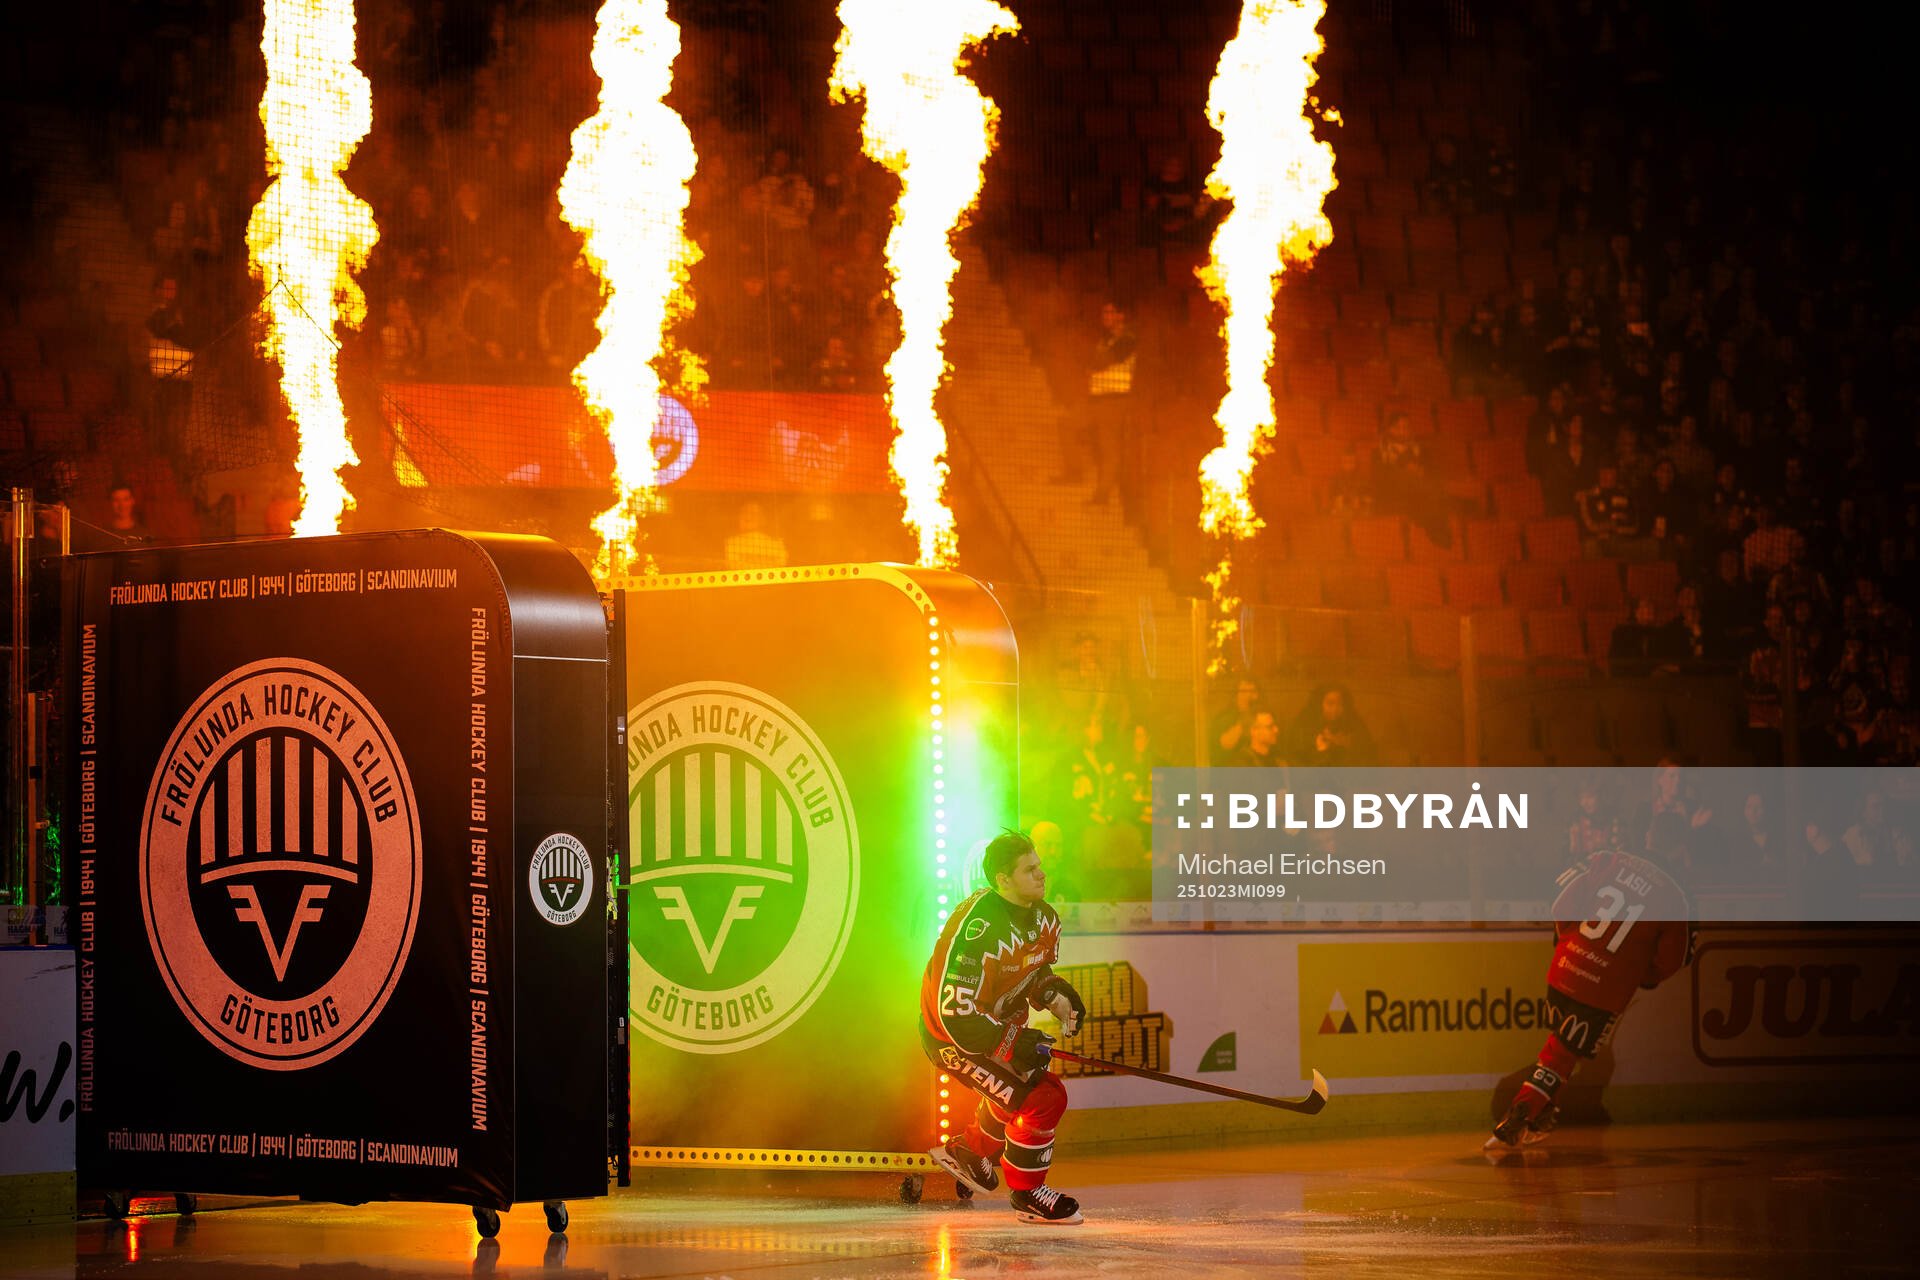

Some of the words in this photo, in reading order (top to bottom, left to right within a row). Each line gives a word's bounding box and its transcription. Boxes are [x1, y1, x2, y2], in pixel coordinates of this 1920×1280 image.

[110, 581, 168, 605] FRÖLUNDA
[171, 580, 216, 601] HOCKEY
[219, 577, 248, 599] CLUB
[259, 575, 285, 595] 1944
[295, 569, 356, 593] GÖTEBORG
[367, 568, 457, 590] SCANDINAVIUM
[471, 607, 490, 697] FRÖLUNDA
[82, 623, 97, 745] SCANDINAVIUM
[161, 692, 255, 827] FRÖLUNDA
[263, 684, 356, 742] HOCKEY
[352, 739, 398, 823] CLUB
[471, 703, 486, 773] HOCKEY
[692, 705, 789, 757] HOCKEY
[785, 752, 834, 828] CLUB
[78, 760, 96, 844] GÖTEBORG
[471, 778, 486, 827] CLUB
[81, 859, 95, 895] 1944
[471, 838, 487, 878] 1944
[81, 911, 95, 951] CLUB
[470, 893, 490, 984] GÖTEBORG
[1579, 885, 1646, 954] 31
[81, 958, 95, 1022] HOCKEY
[220, 993, 340, 1044] GÖTEBORG
[646, 984, 774, 1030] GÖTEBORG
[941, 984, 975, 1016] 25
[1054, 961, 1134, 1017] URO
[78, 1027, 94, 1112] FRÖLUNDA
[470, 999, 488, 1131] SCANDINAVIUM
[947, 1057, 1015, 1105] STENA
[108, 1127, 165, 1152] FRÖLUNDA
[169, 1133, 216, 1153] HOCKEY
[219, 1134, 249, 1154] CLUB
[260, 1135, 286, 1156] 1944
[296, 1133, 357, 1160] GÖTEBORG
[367, 1141, 458, 1168] SCANDINAVIUM
